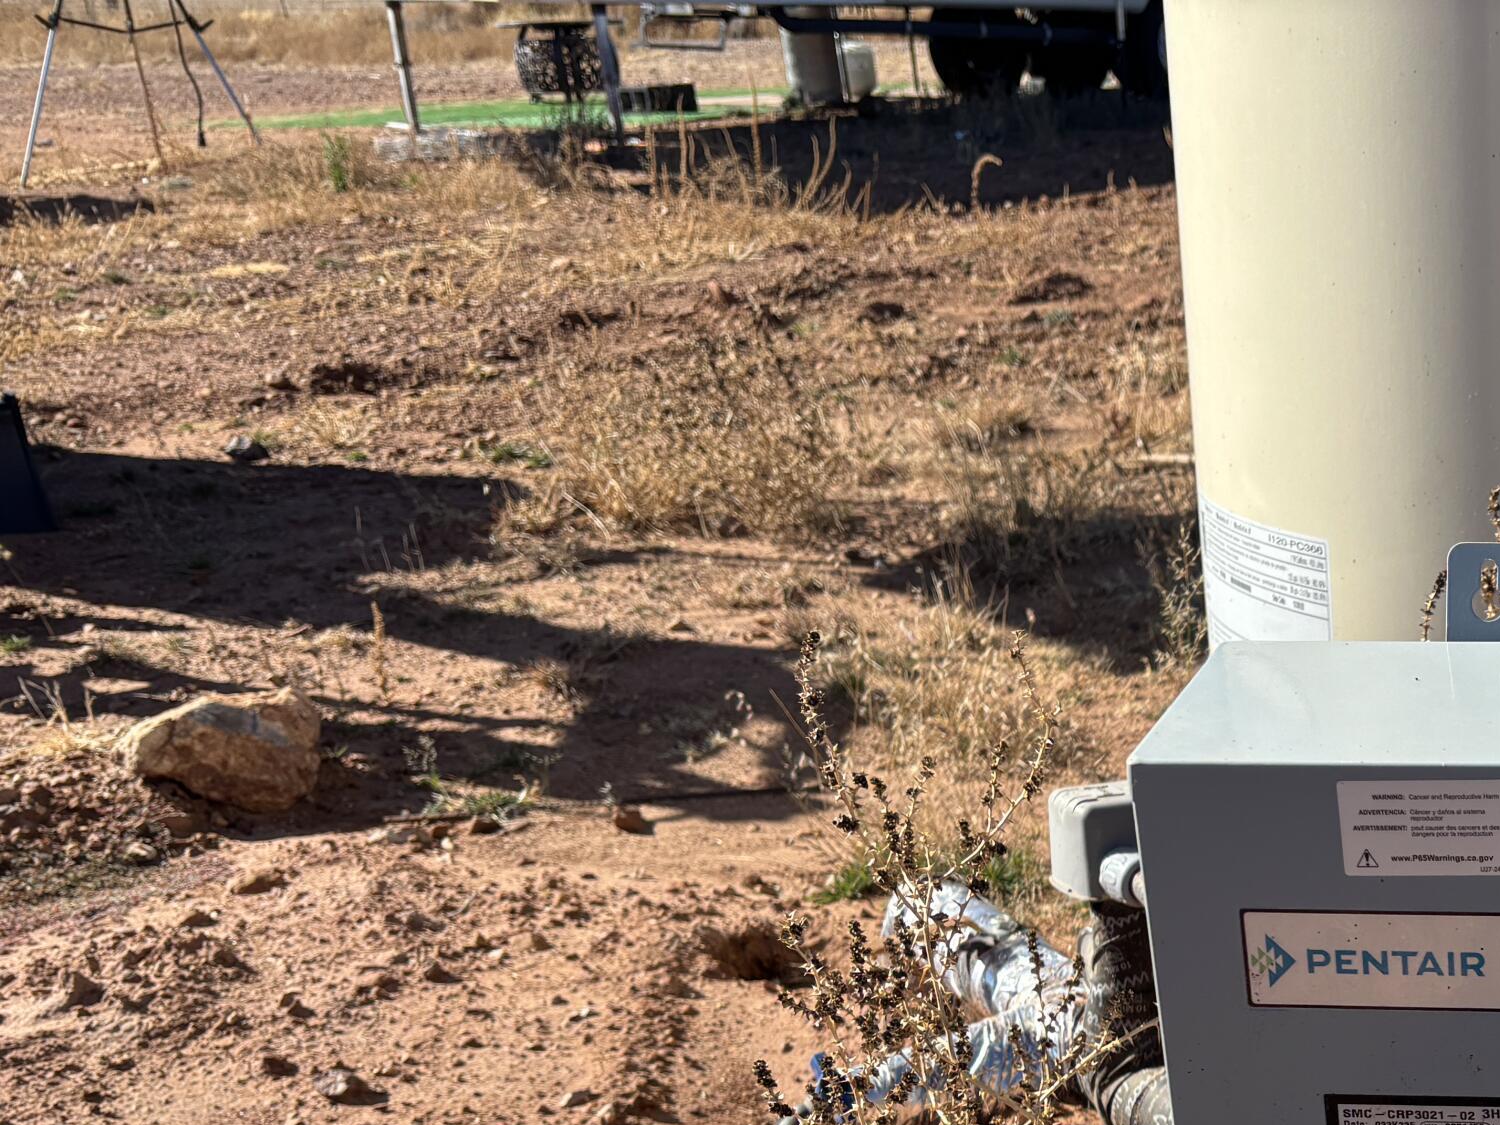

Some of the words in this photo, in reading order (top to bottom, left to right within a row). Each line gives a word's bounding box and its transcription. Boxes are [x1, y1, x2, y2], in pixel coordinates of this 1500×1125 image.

[1443, 793, 1482, 801] Reproductive
[1390, 854, 1494, 863] www.P65Warnings.ca.gov
[1305, 948, 1486, 977] PENTAIR
